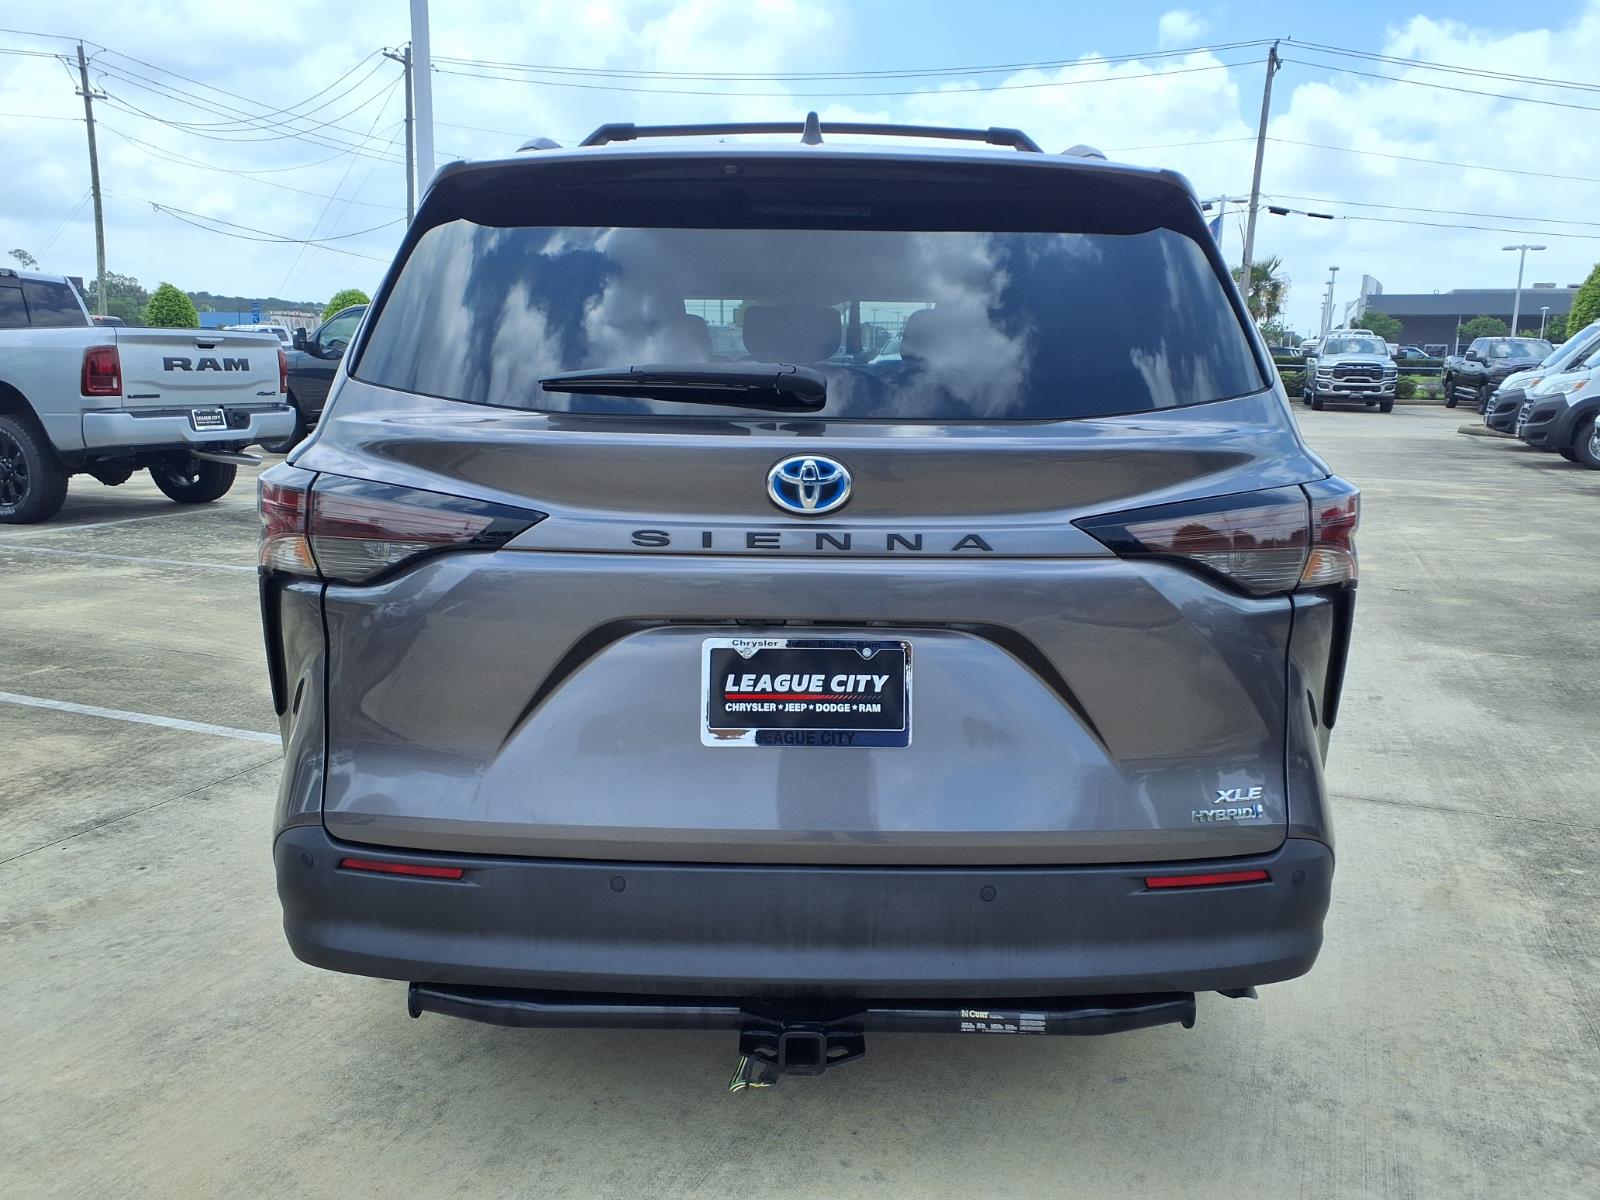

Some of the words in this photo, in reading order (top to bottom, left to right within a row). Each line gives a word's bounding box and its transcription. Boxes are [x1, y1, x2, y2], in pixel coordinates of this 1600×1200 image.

[163, 356, 250, 372] RAM
[631, 529, 994, 551] SIENNA
[732, 639, 778, 648] Chrysler
[725, 674, 826, 692] LEAGUE
[830, 674, 889, 693] CITY
[725, 702, 777, 712] CHRYSLER
[784, 703, 807, 712] JEEP
[815, 703, 850, 712] DODGE
[859, 703, 881, 713] RAM
[821, 731, 855, 745] CITY
[1212, 786, 1263, 804] XLE
[1191, 807, 1256, 823] HYBRID
